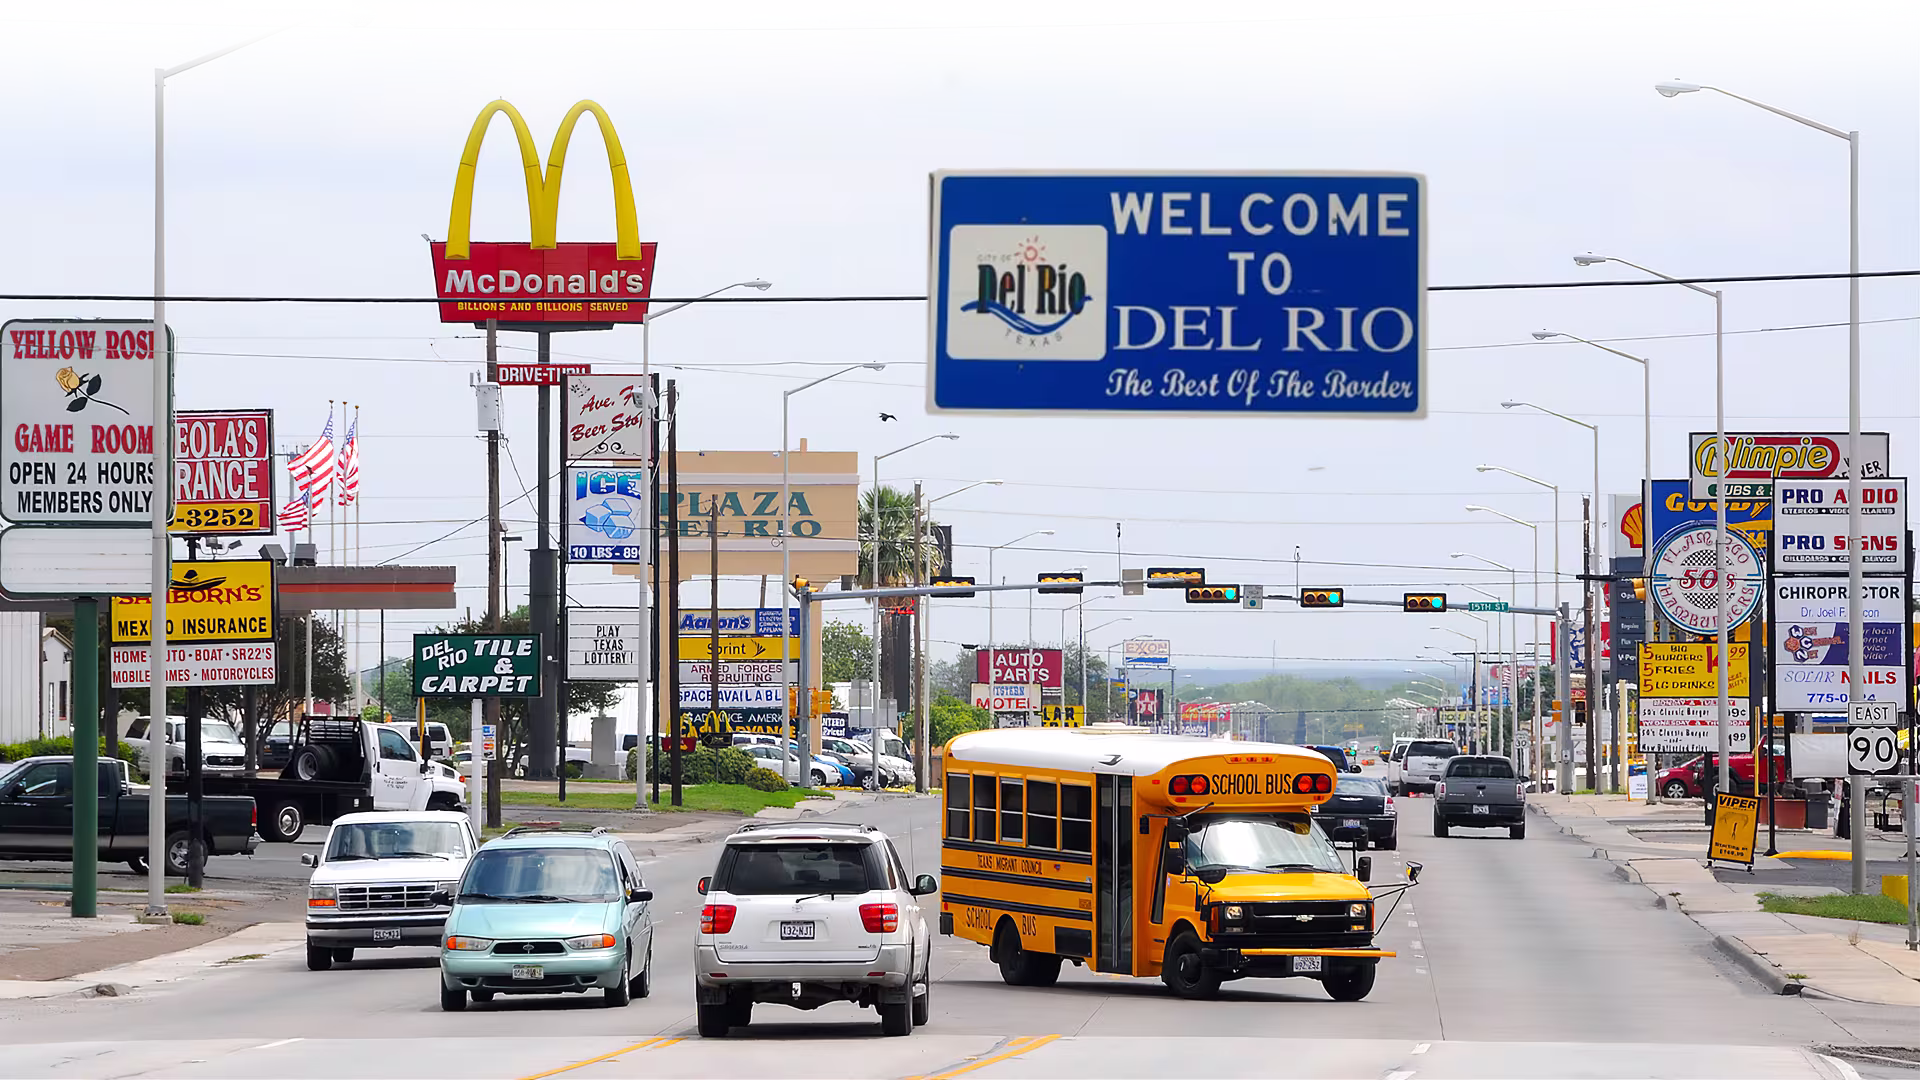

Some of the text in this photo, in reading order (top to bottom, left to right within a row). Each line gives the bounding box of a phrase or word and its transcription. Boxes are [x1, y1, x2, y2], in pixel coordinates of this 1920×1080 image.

[1110, 193, 1409, 236] WELCOME
[1228, 251, 1292, 295] TO
[444, 270, 644, 294] McDonald's
[976, 263, 1086, 315] Del Rio
[457, 302, 629, 311] BILLIONS AND BILLIONS SERVED
[1005, 327, 1063, 347] TEXAS
[1113, 305, 1413, 353] DEL RIO
[10, 330, 96, 360] YELLOW
[1106, 368, 1413, 405] The Best Of The Border
[579, 394, 616, 415] Ave.
[15, 424, 154, 454] GAME ROOM
[177, 420, 258, 458] EOLA'S
[570, 424, 607, 441] Beer
[1695, 437, 1829, 478] Blimpie
[10, 462, 154, 484] OPEN 24 HOURS
[176, 461, 259, 499] RANCE
[576, 471, 642, 500] ICE
[1718, 485, 1751, 496] UBS
[1756, 486, 1765, 496] &
[18, 490, 153, 513] MEMBERS ONLY
[660, 492, 813, 516] PLAZA
[1782, 489, 1823, 504] PRO
[1833, 488, 1898, 504] ADIO
[170, 508, 254, 526] -3252
[743, 520, 821, 537] RIO
[1782, 535, 1825, 550] PRO
[1834, 535, 1898, 551] SGNS
[572, 546, 641, 560] 10 LBS 89
[1779, 586, 1900, 599] CHIROPRCTOR
[1801, 607, 1814, 617] Dr.
[1817, 607, 1837, 617] Joel
[1863, 609, 1880, 617] con
[118, 617, 267, 637] MEXIO INSURANCE
[680, 613, 751, 630] Aaon's
[1872, 627, 1895, 635] local
[113, 648, 272, 663] HOME UTO BOAT SR22'S
[422, 640, 453, 660] DEL
[474, 640, 533, 656] TILE
[1643, 645, 1746, 662] 5 BURGERS 99
[438, 649, 468, 671] RIO
[493, 657, 514, 675] &
[995, 653, 1043, 667] AUTO
[113, 667, 274, 683] MOBILE MES MOTORCYCLES
[737, 665, 782, 673] FORCES
[994, 668, 1049, 681] PARTS
[1643, 662, 1695, 677] 5 FRIES
[1784, 670, 1835, 683] SOLAR
[422, 676, 532, 692] CARPET
[702, 674, 772, 682] RCRUITING
[1642, 679, 1715, 692] 5 LG DRINKS
[718, 689, 782, 701] AVAILABL
[822, 717, 845, 727] NTEED
[1043, 707, 1074, 721] LAR
[1855, 707, 1888, 720] EAST
[1853, 737, 1893, 762] 90
[1211, 774, 1292, 794] SCHOOL BUS
[1719, 796, 1757, 809] VIPER
[977, 854, 1043, 875] TEXAS MIGRANT COUNCIL
[966, 907, 1037, 936] SCHOOL BUS
